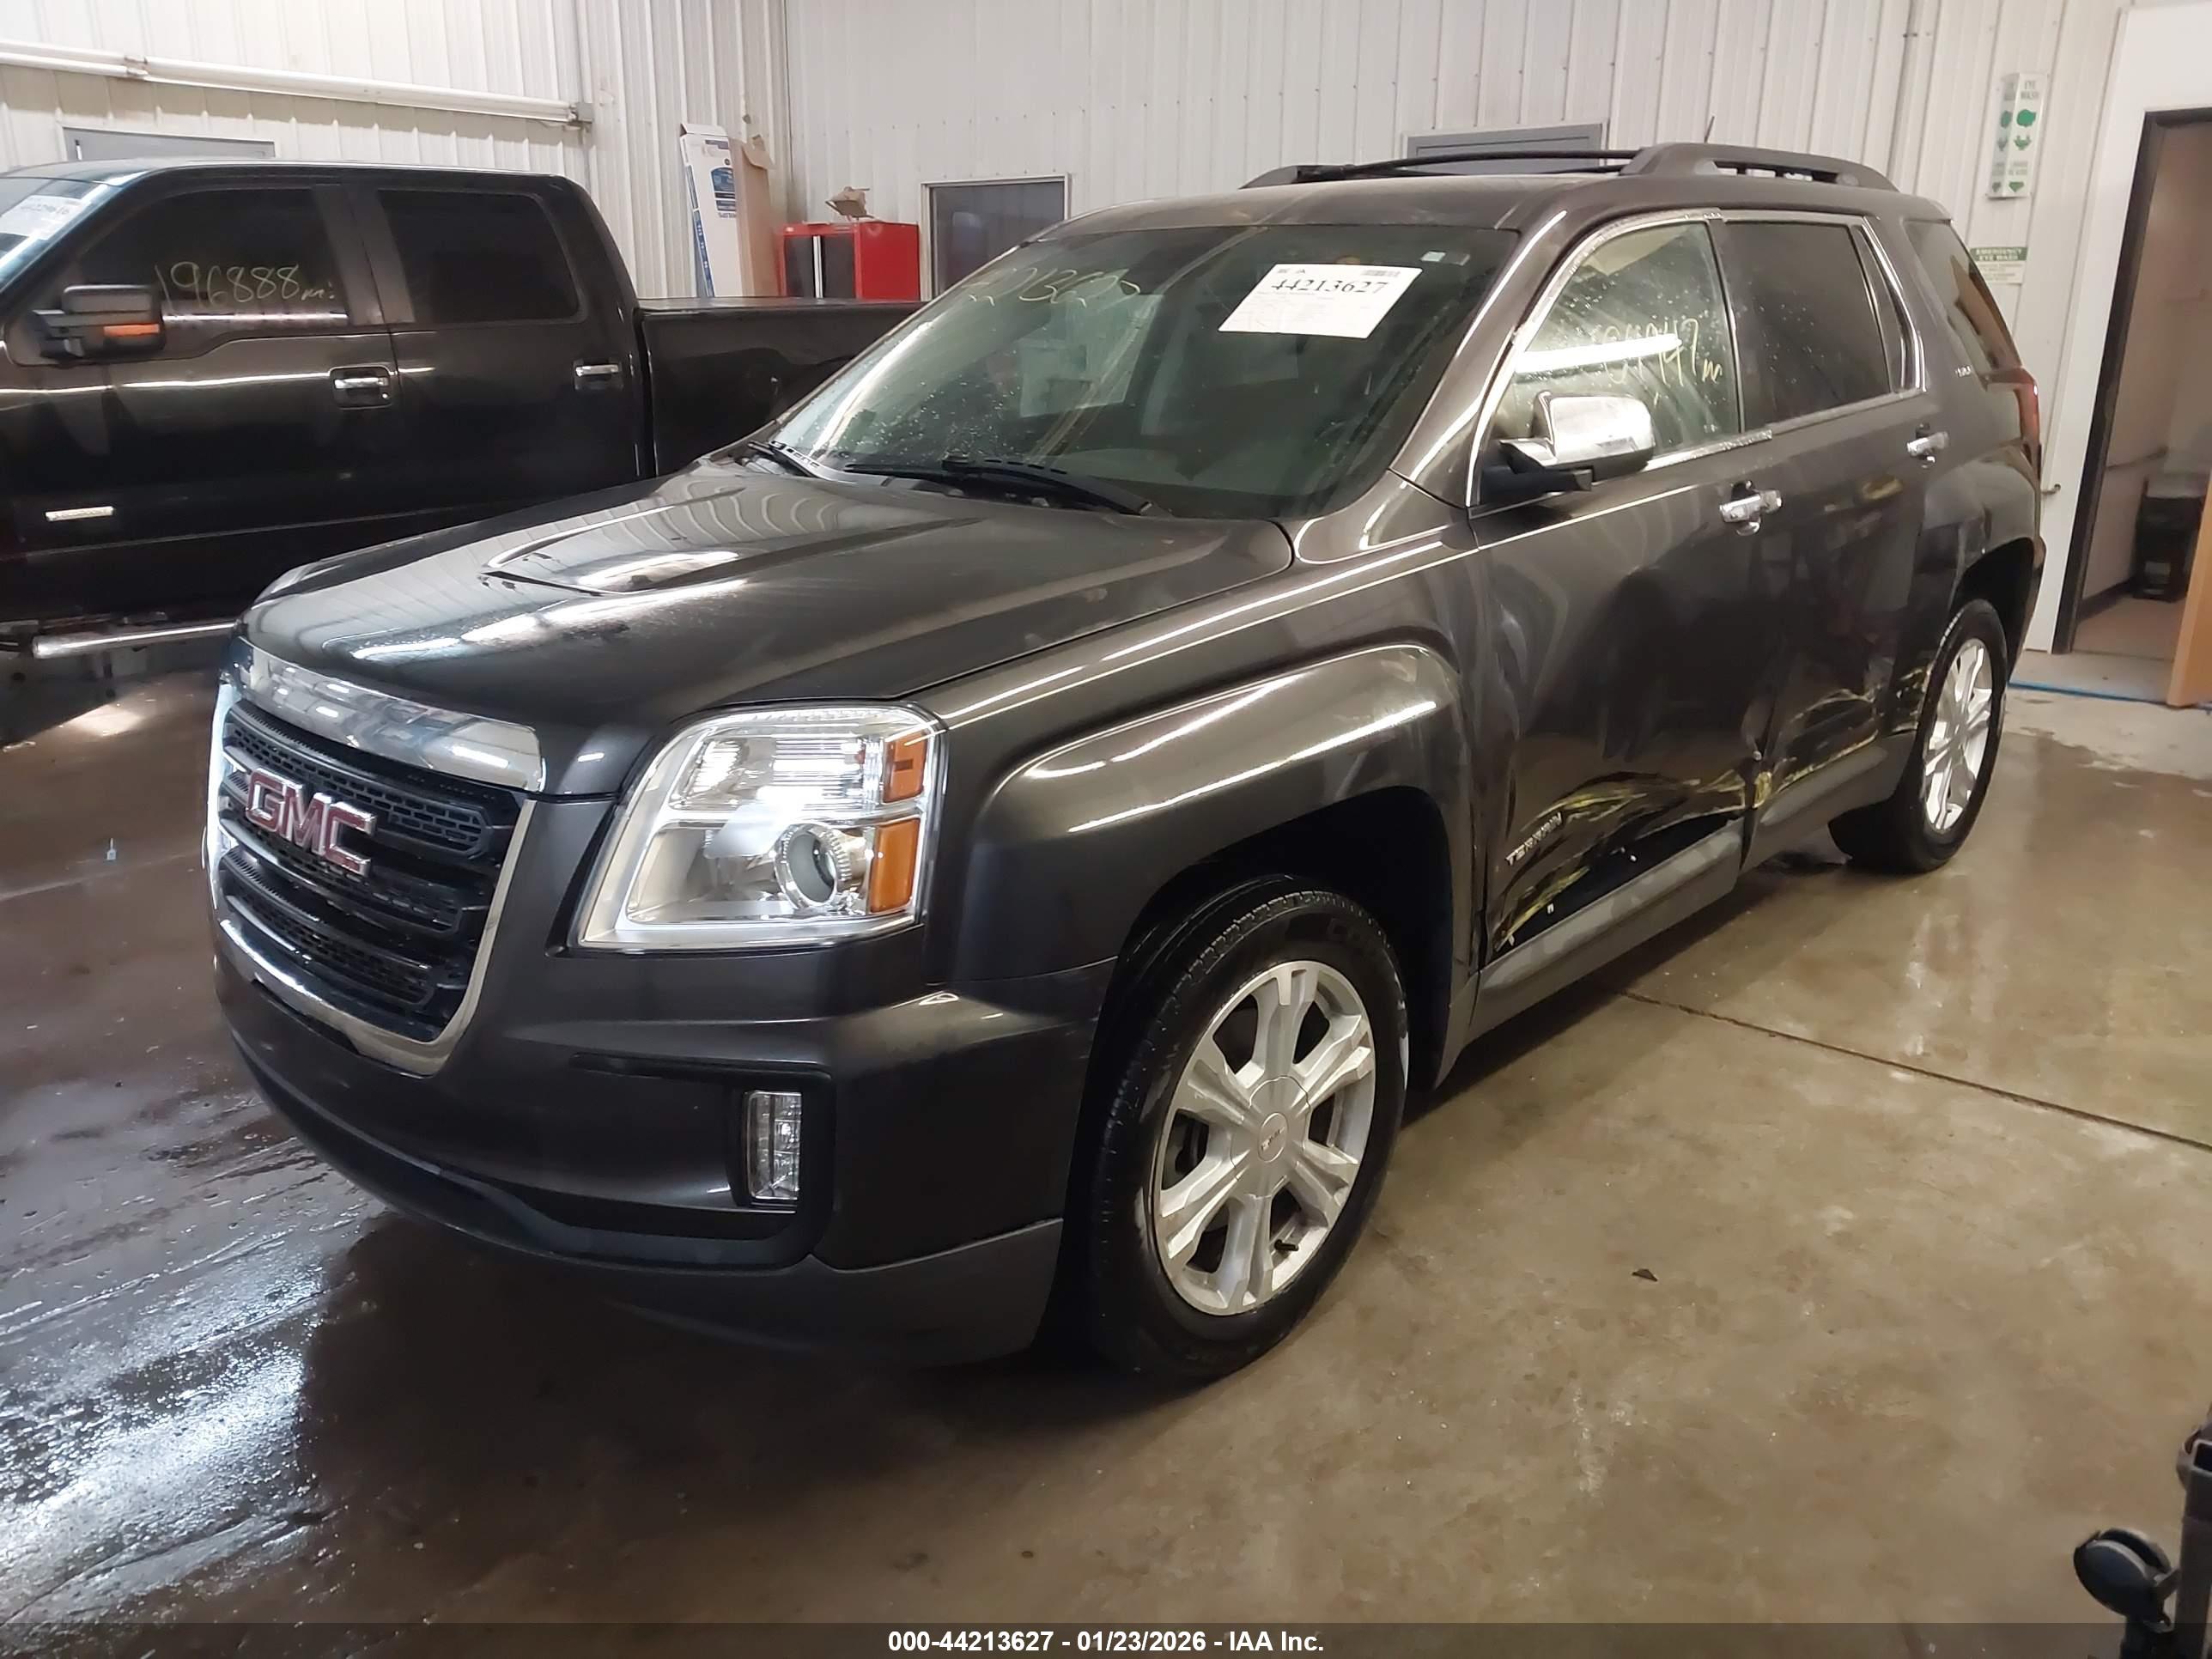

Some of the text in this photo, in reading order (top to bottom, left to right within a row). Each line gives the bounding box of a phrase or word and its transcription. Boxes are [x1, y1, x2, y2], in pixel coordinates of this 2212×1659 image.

[155, 261, 299, 306] 196888
[1271, 278, 1389, 295] 44213627
[246, 768, 376, 878] GMC
[1504, 811, 1563, 866] TERRAIN
